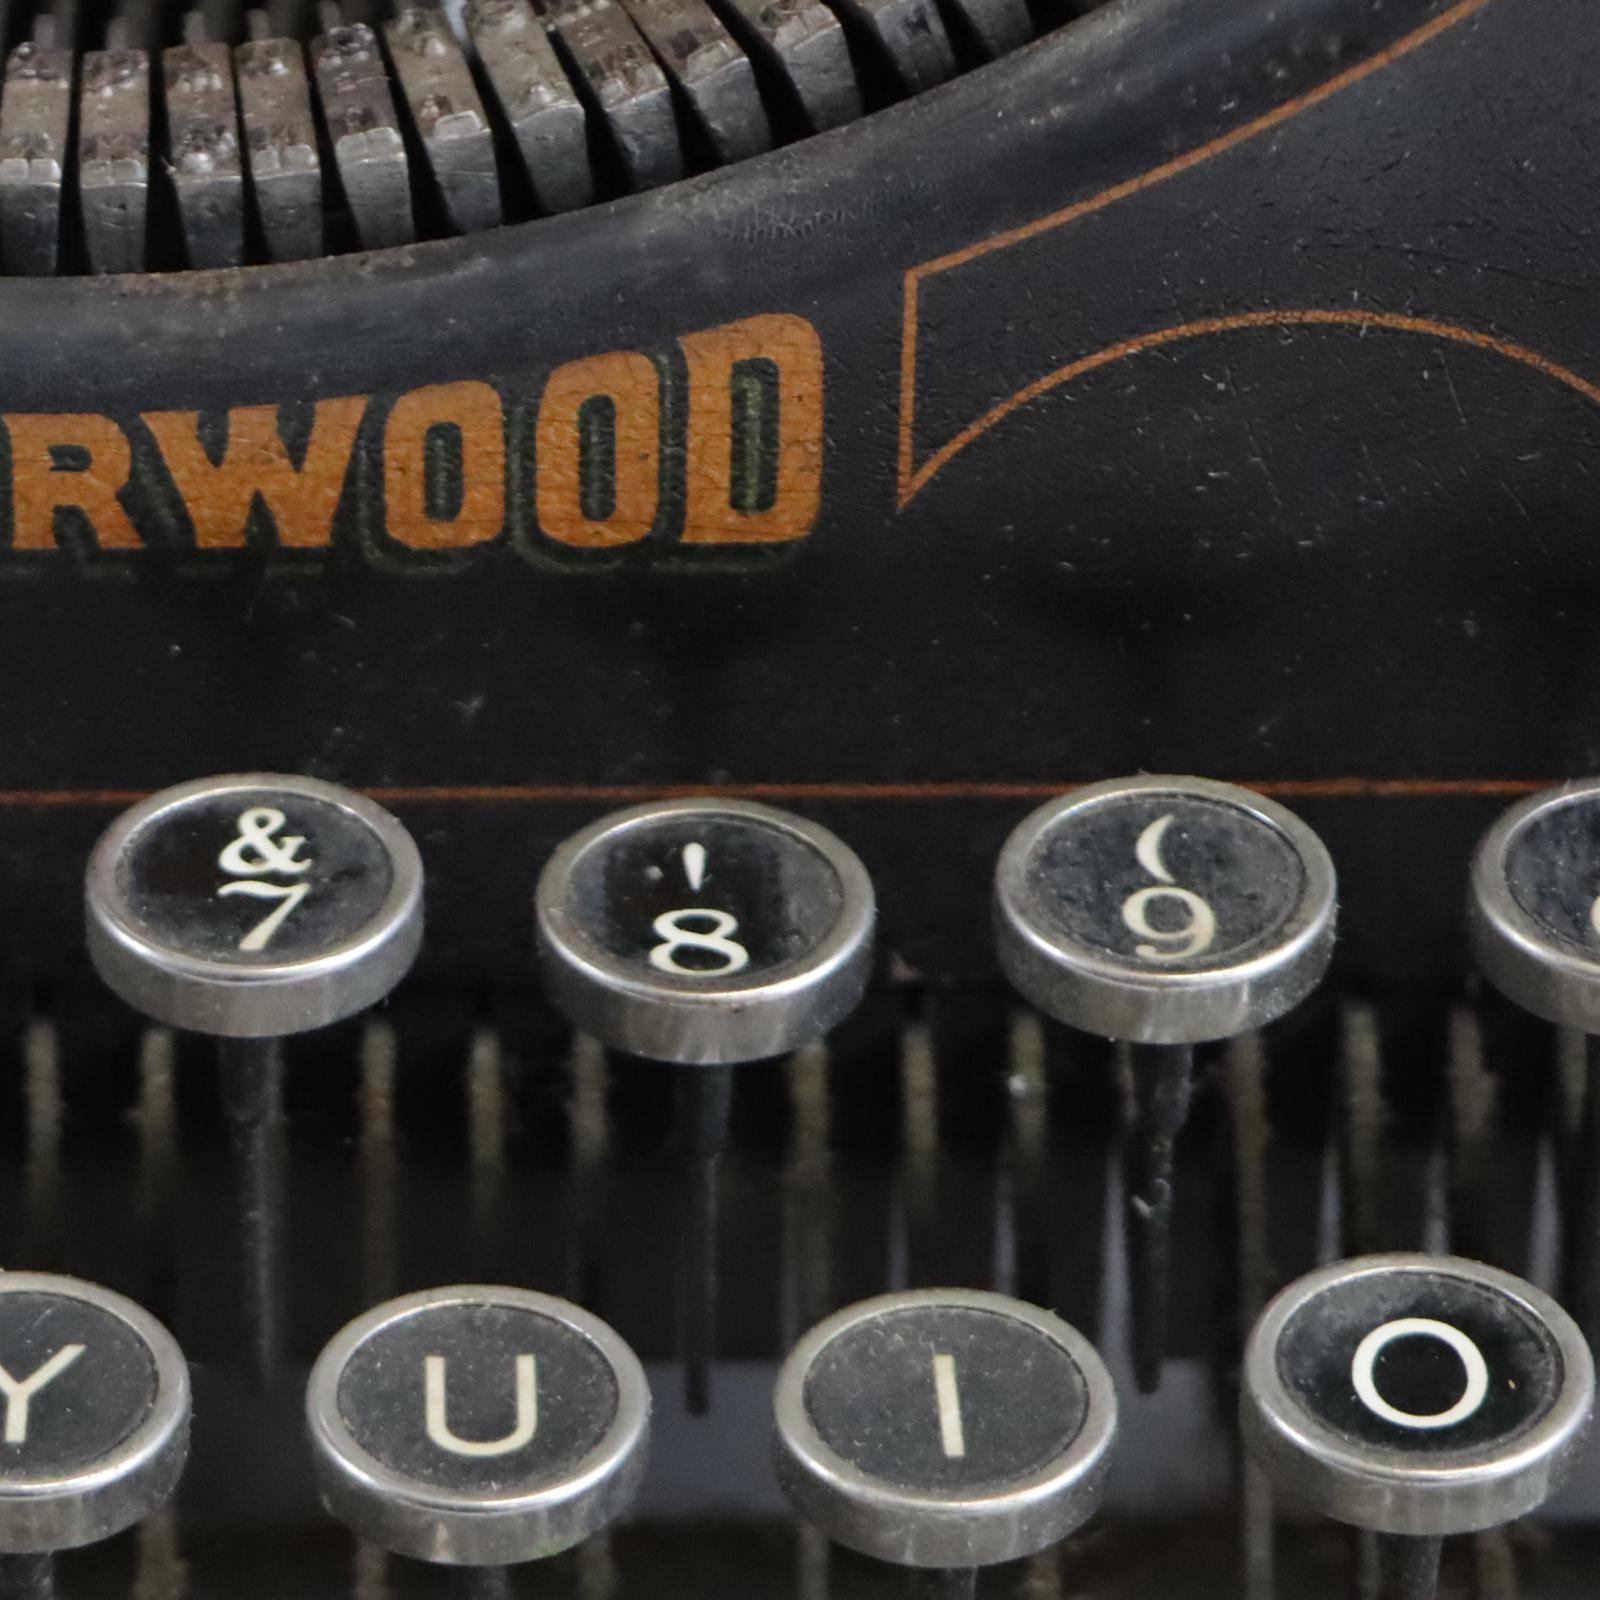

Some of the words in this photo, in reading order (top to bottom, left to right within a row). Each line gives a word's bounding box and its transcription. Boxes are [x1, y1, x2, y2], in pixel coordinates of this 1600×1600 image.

[218, 806, 313, 876] &
[1134, 813, 1176, 884] (
[216, 879, 312, 954] 7
[648, 907, 750, 979] 8
[1120, 885, 1217, 962] 9
[423, 1353, 539, 1458] U
[931, 1353, 966, 1459] I
[1350, 1316, 1490, 1430] O
